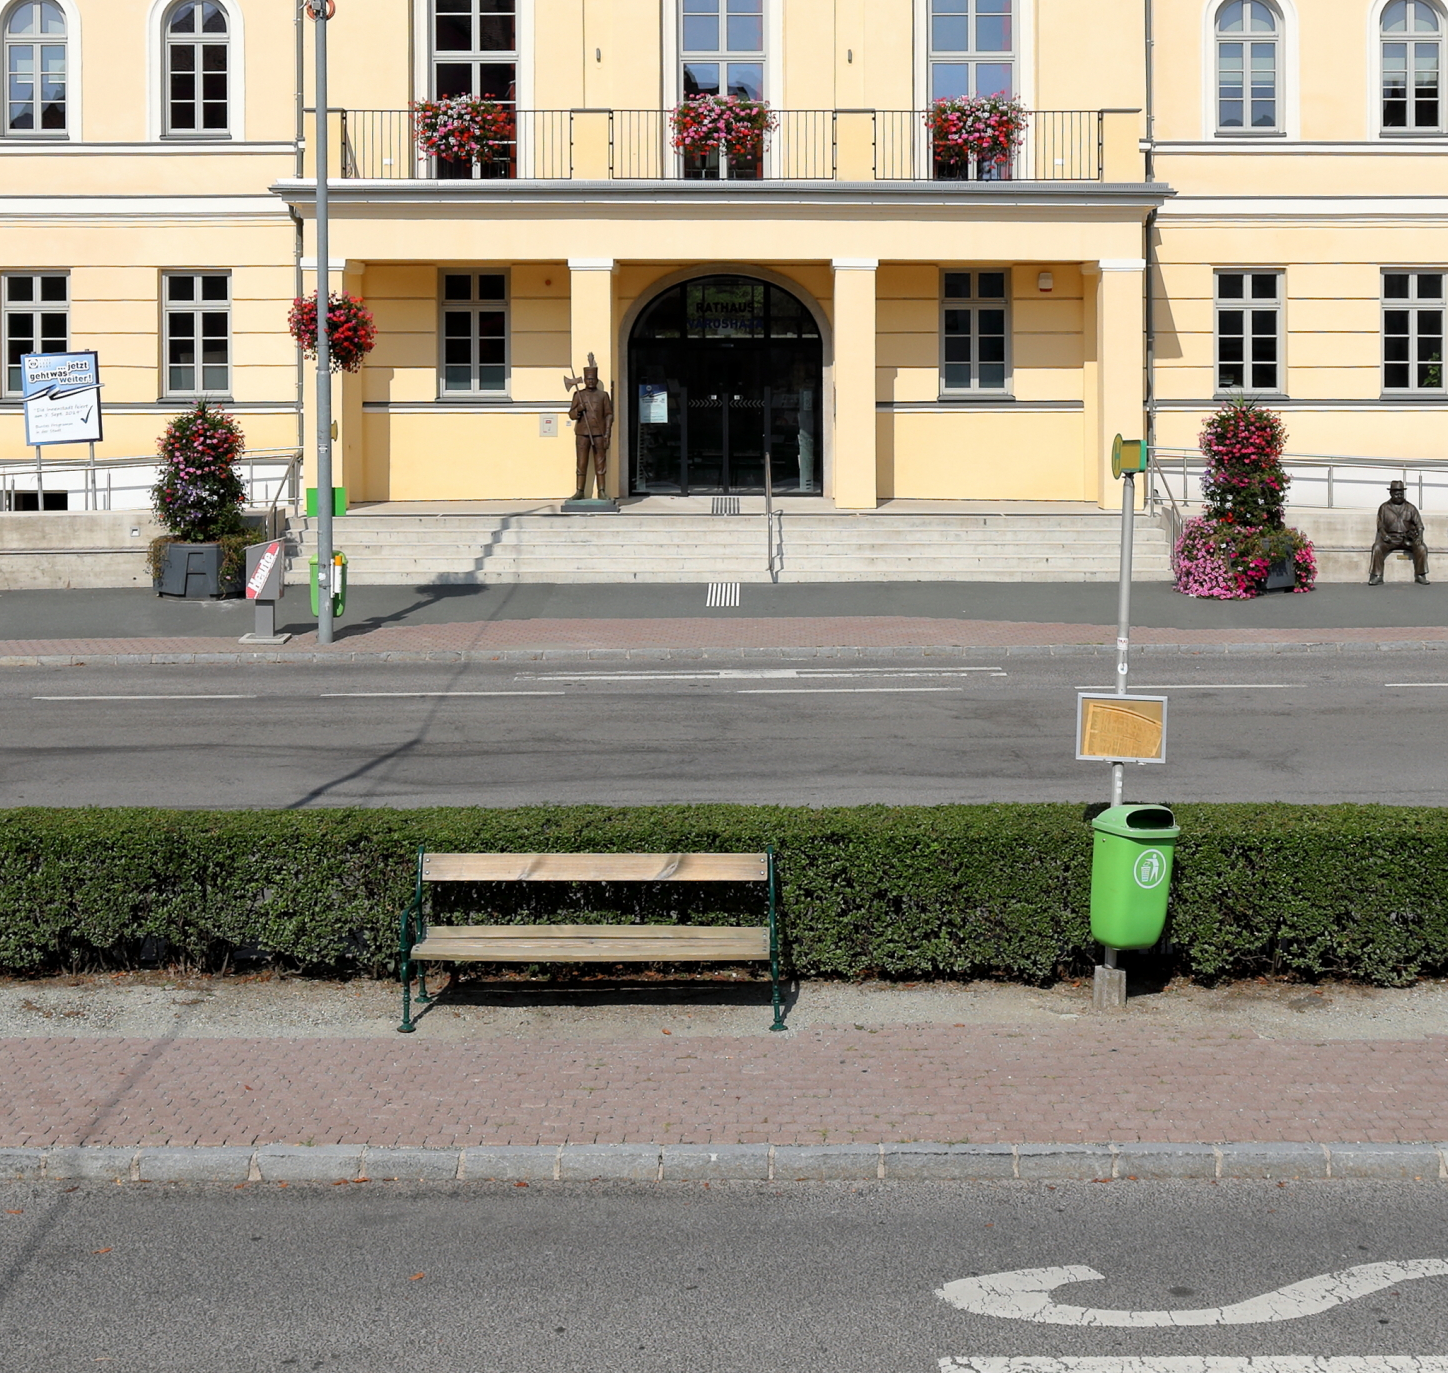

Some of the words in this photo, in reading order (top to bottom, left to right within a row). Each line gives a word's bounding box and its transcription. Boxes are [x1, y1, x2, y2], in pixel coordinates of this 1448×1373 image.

[696, 302, 754, 313] RATHAUS
[30, 372, 50, 382] geht
[50, 369, 68, 377] was
[60, 374, 92, 384] weiter!
[248, 550, 275, 593] Heute
